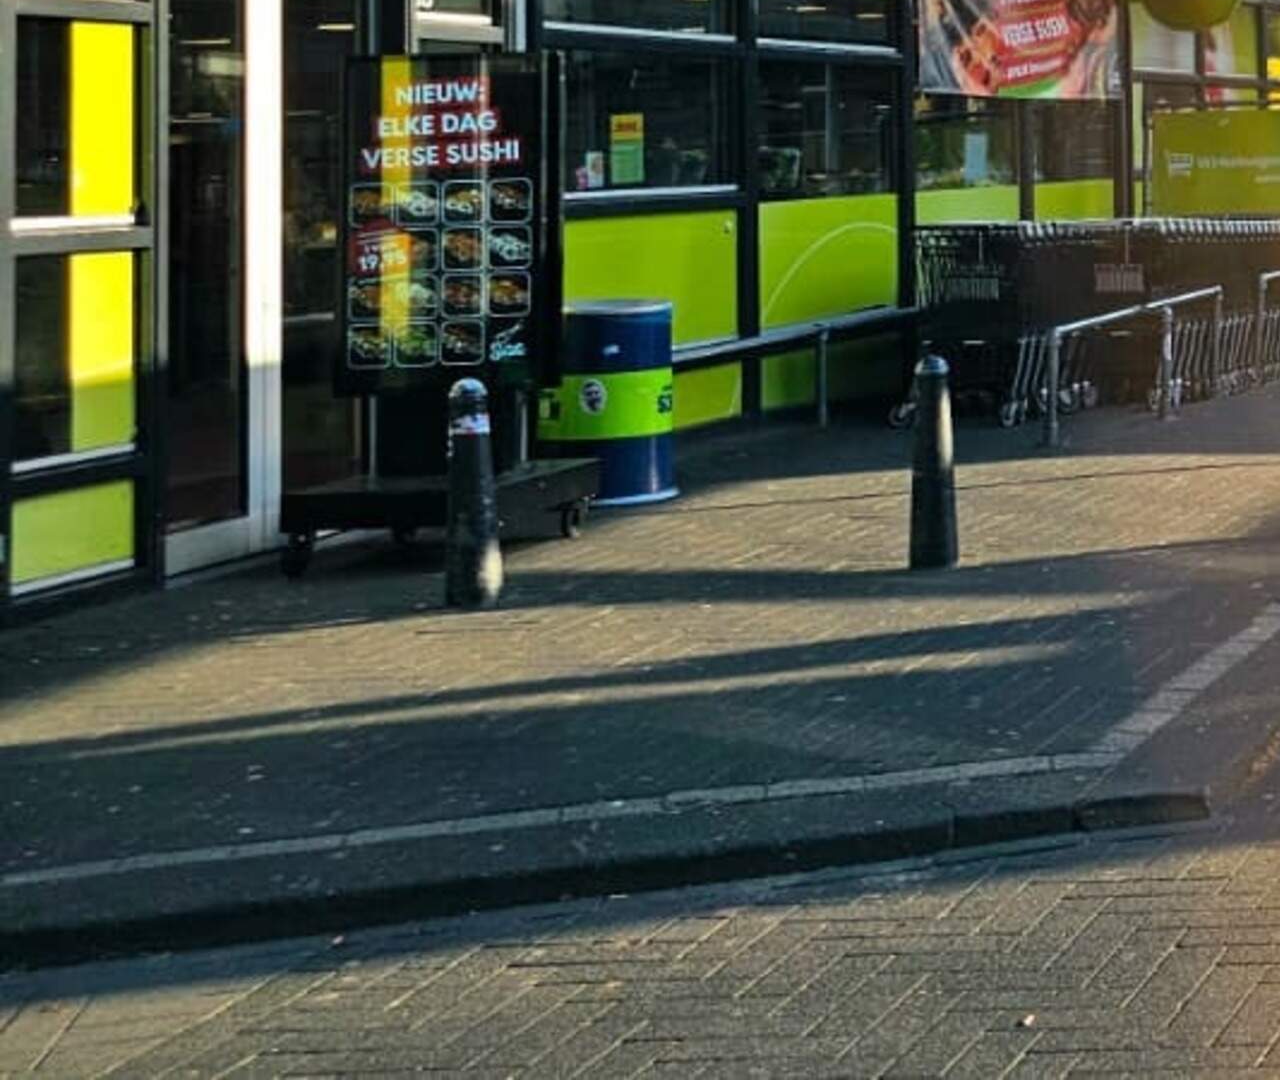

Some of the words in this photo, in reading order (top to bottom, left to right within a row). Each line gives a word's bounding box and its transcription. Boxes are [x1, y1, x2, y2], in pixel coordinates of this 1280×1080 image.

[395, 81, 486, 106] NIEUW:
[378, 114, 436, 138] ELKE
[441, 111, 498, 134] DAG
[361, 144, 440, 170] VERSE
[446, 139, 520, 165] SUSHI
